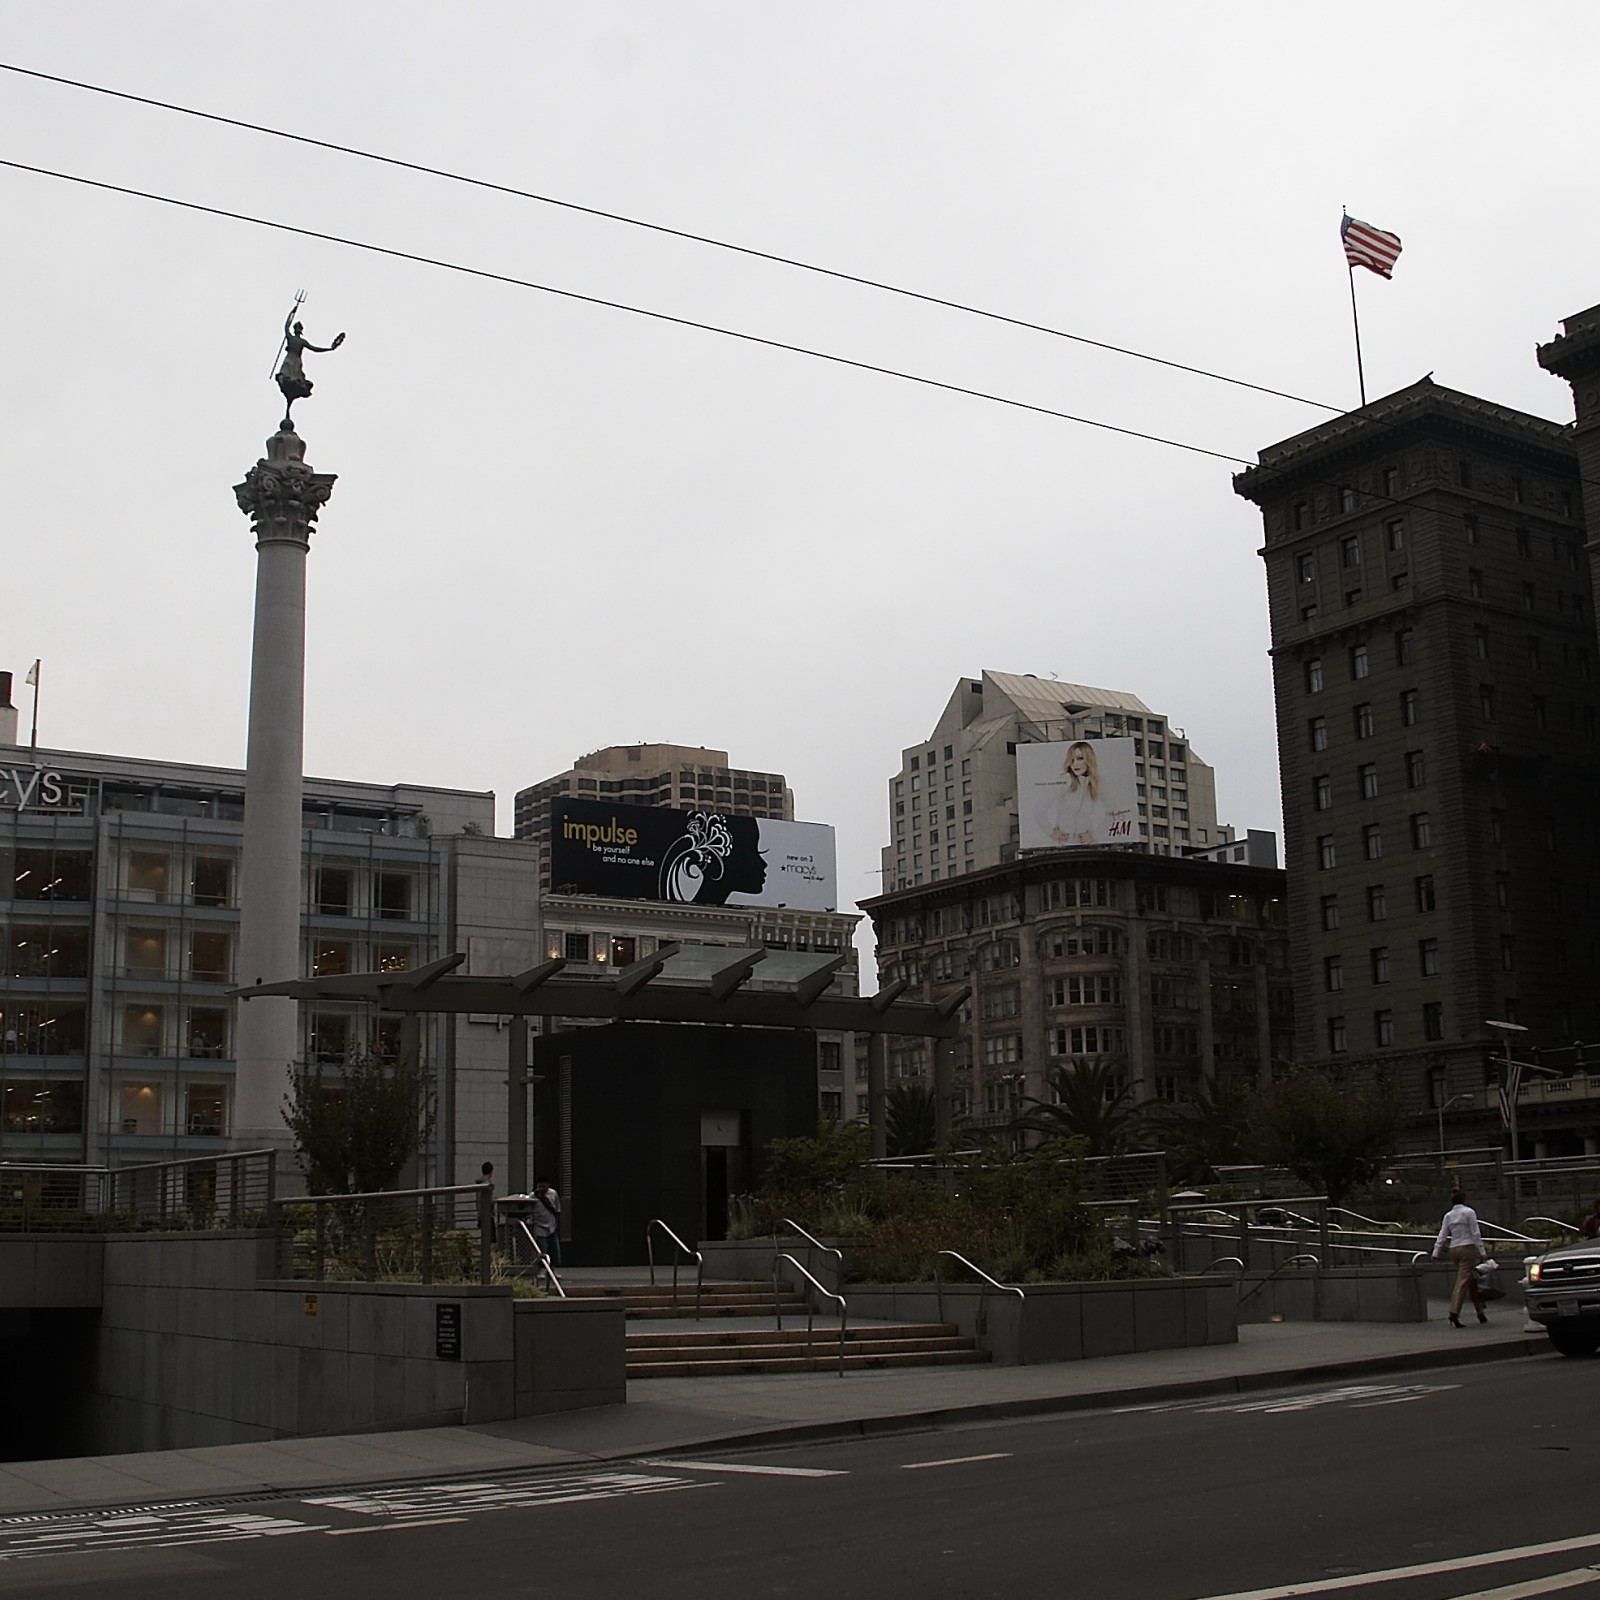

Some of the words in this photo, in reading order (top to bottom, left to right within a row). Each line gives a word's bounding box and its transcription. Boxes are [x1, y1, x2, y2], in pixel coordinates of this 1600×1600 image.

[563, 814, 638, 848] impulse
[592, 843, 602, 852] be
[603, 845, 630, 855] yourself
[602, 854, 616, 863] and
[641, 857, 655, 867] else
